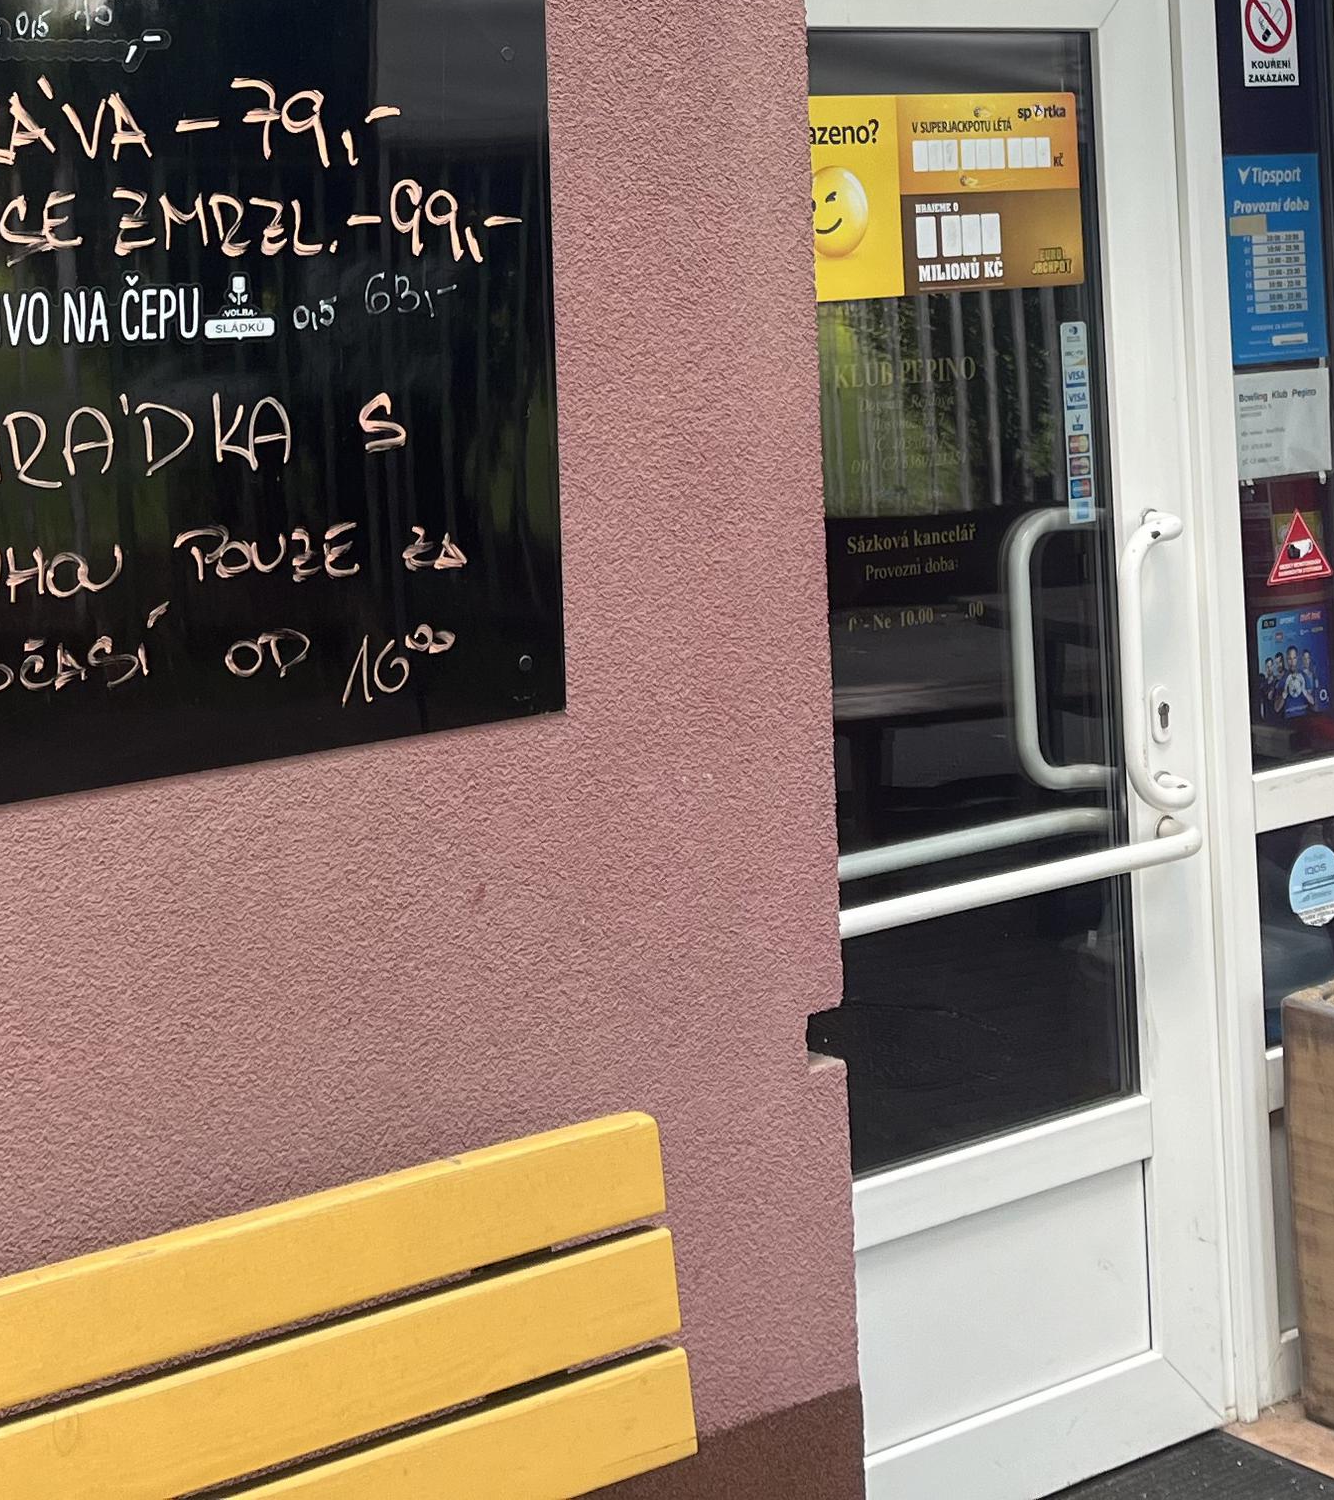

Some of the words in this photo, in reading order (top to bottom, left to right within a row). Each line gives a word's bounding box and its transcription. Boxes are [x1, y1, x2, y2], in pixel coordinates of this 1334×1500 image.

[1251, 58, 1292, 71] KOUŘENÍ
[1247, 71, 1297, 85] ZAKÁZÁNO
[912, 121, 919, 133] V
[920, 119, 992, 133] SUPERJACKPOTU
[992, 117, 1013, 132] LÉTÁ
[1251, 166, 1302, 187] Tipsport
[1233, 197, 1282, 215] Provozní
[1283, 196, 1310, 212] doba
[918, 256, 981, 283] MILIONŮ
[983, 256, 1004, 279] KČ
[63, 289, 109, 345] NA
[119, 275, 200, 342] ČEPU
[293, 295, 338, 332] 0,5
[835, 361, 894, 388] KLUB
[901, 356, 977, 384] PEPINO
[1068, 369, 1086, 381] VISA
[1069, 391, 1086, 403] VISA
[1238, 392, 1268, 403] Bowling
[1271, 389, 1289, 400] Klub
[1291, 387, 1317, 399] Pepino
[358, 392, 407, 452] S
[847, 529, 909, 555] Sázková
[914, 523, 977, 547] kancelář
[174, 521, 360, 581] POUZE
[400, 526, 468, 572] ZA
[873, 613, 892, 631] Ne
[899, 606, 935, 628] 10.00
[224, 631, 310, 678] OD
[1304, 862, 1327, 876] IQOS
